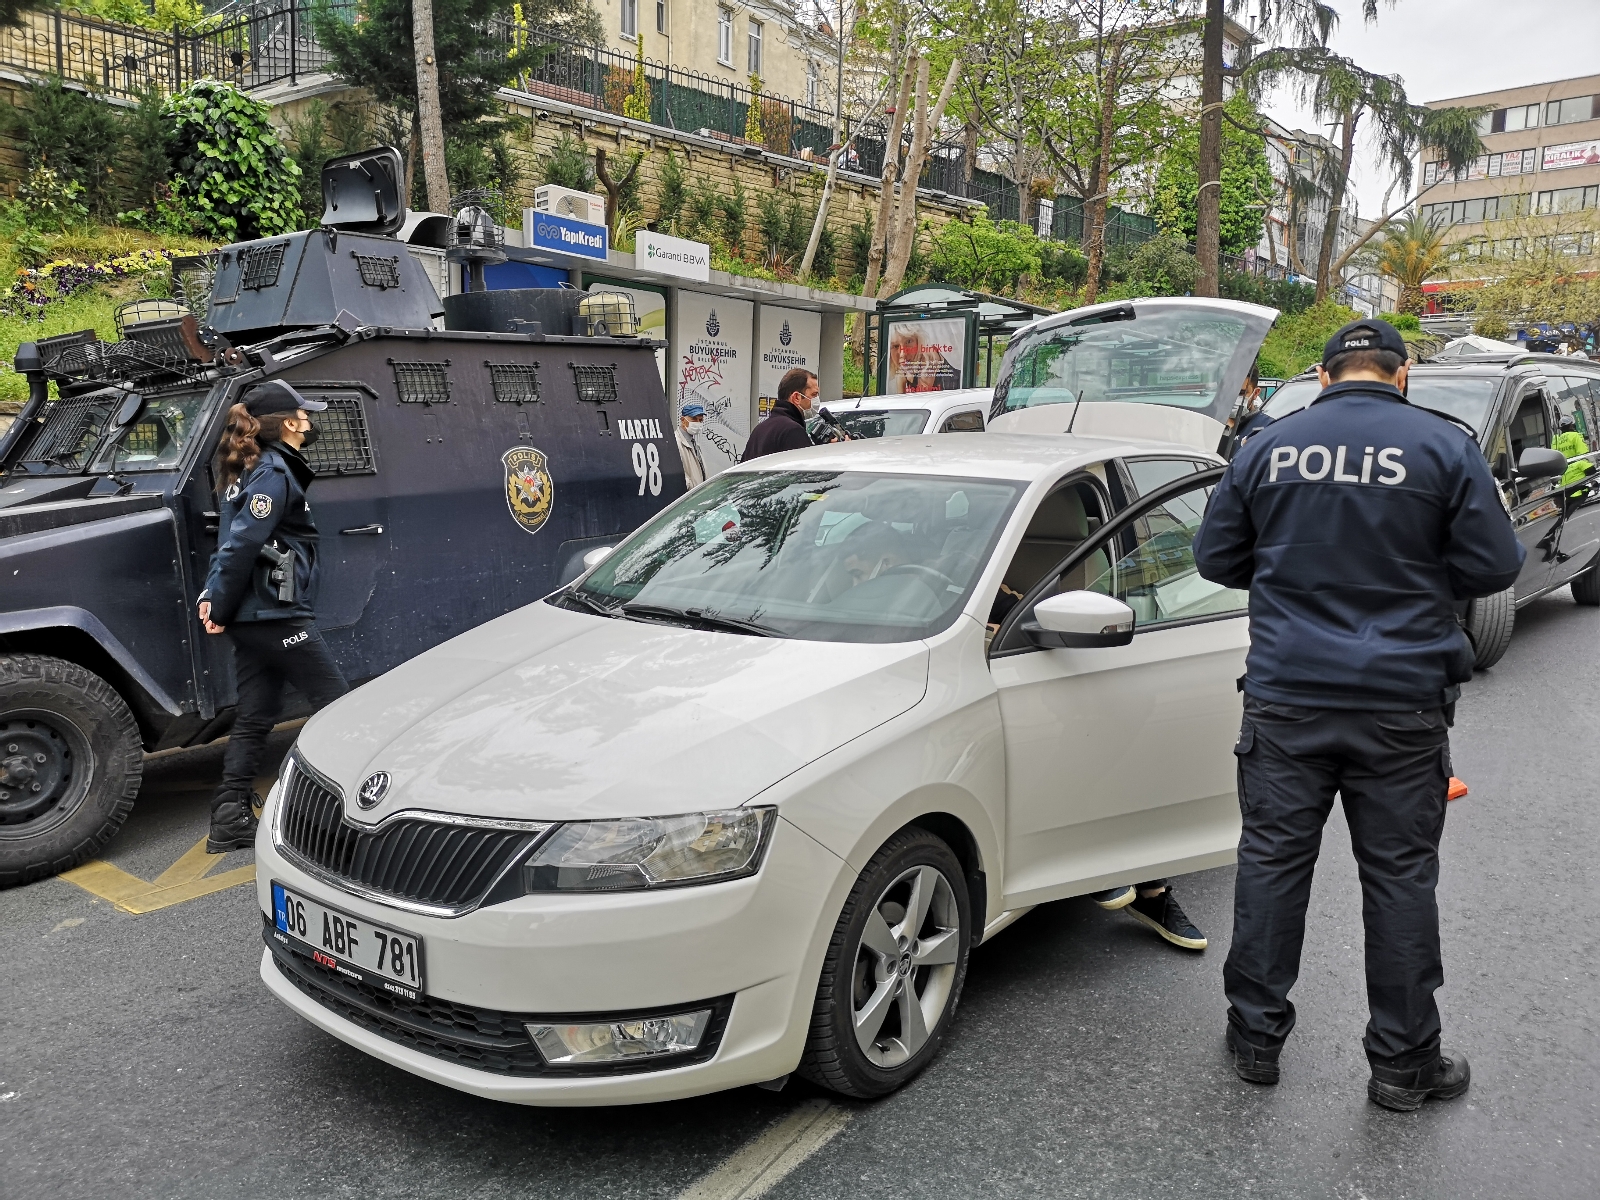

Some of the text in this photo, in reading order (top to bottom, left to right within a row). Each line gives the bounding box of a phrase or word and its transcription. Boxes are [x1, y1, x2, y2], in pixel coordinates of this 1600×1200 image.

[655, 247, 706, 266] Garanti BBVA
[697, 338, 728, 347] İSTANBUL
[771, 347, 799, 355] İSTANBUL
[697, 356, 728, 365] BELEDYESİ
[763, 351, 806, 367] BÜYÜKŞEHİR
[618, 418, 663, 439] KARTAL
[631, 442, 663, 496] 98
[277, 909, 286, 922] TR
[285, 895, 416, 982] 06 ABF 781
[313, 950, 363, 981] NTS motors
